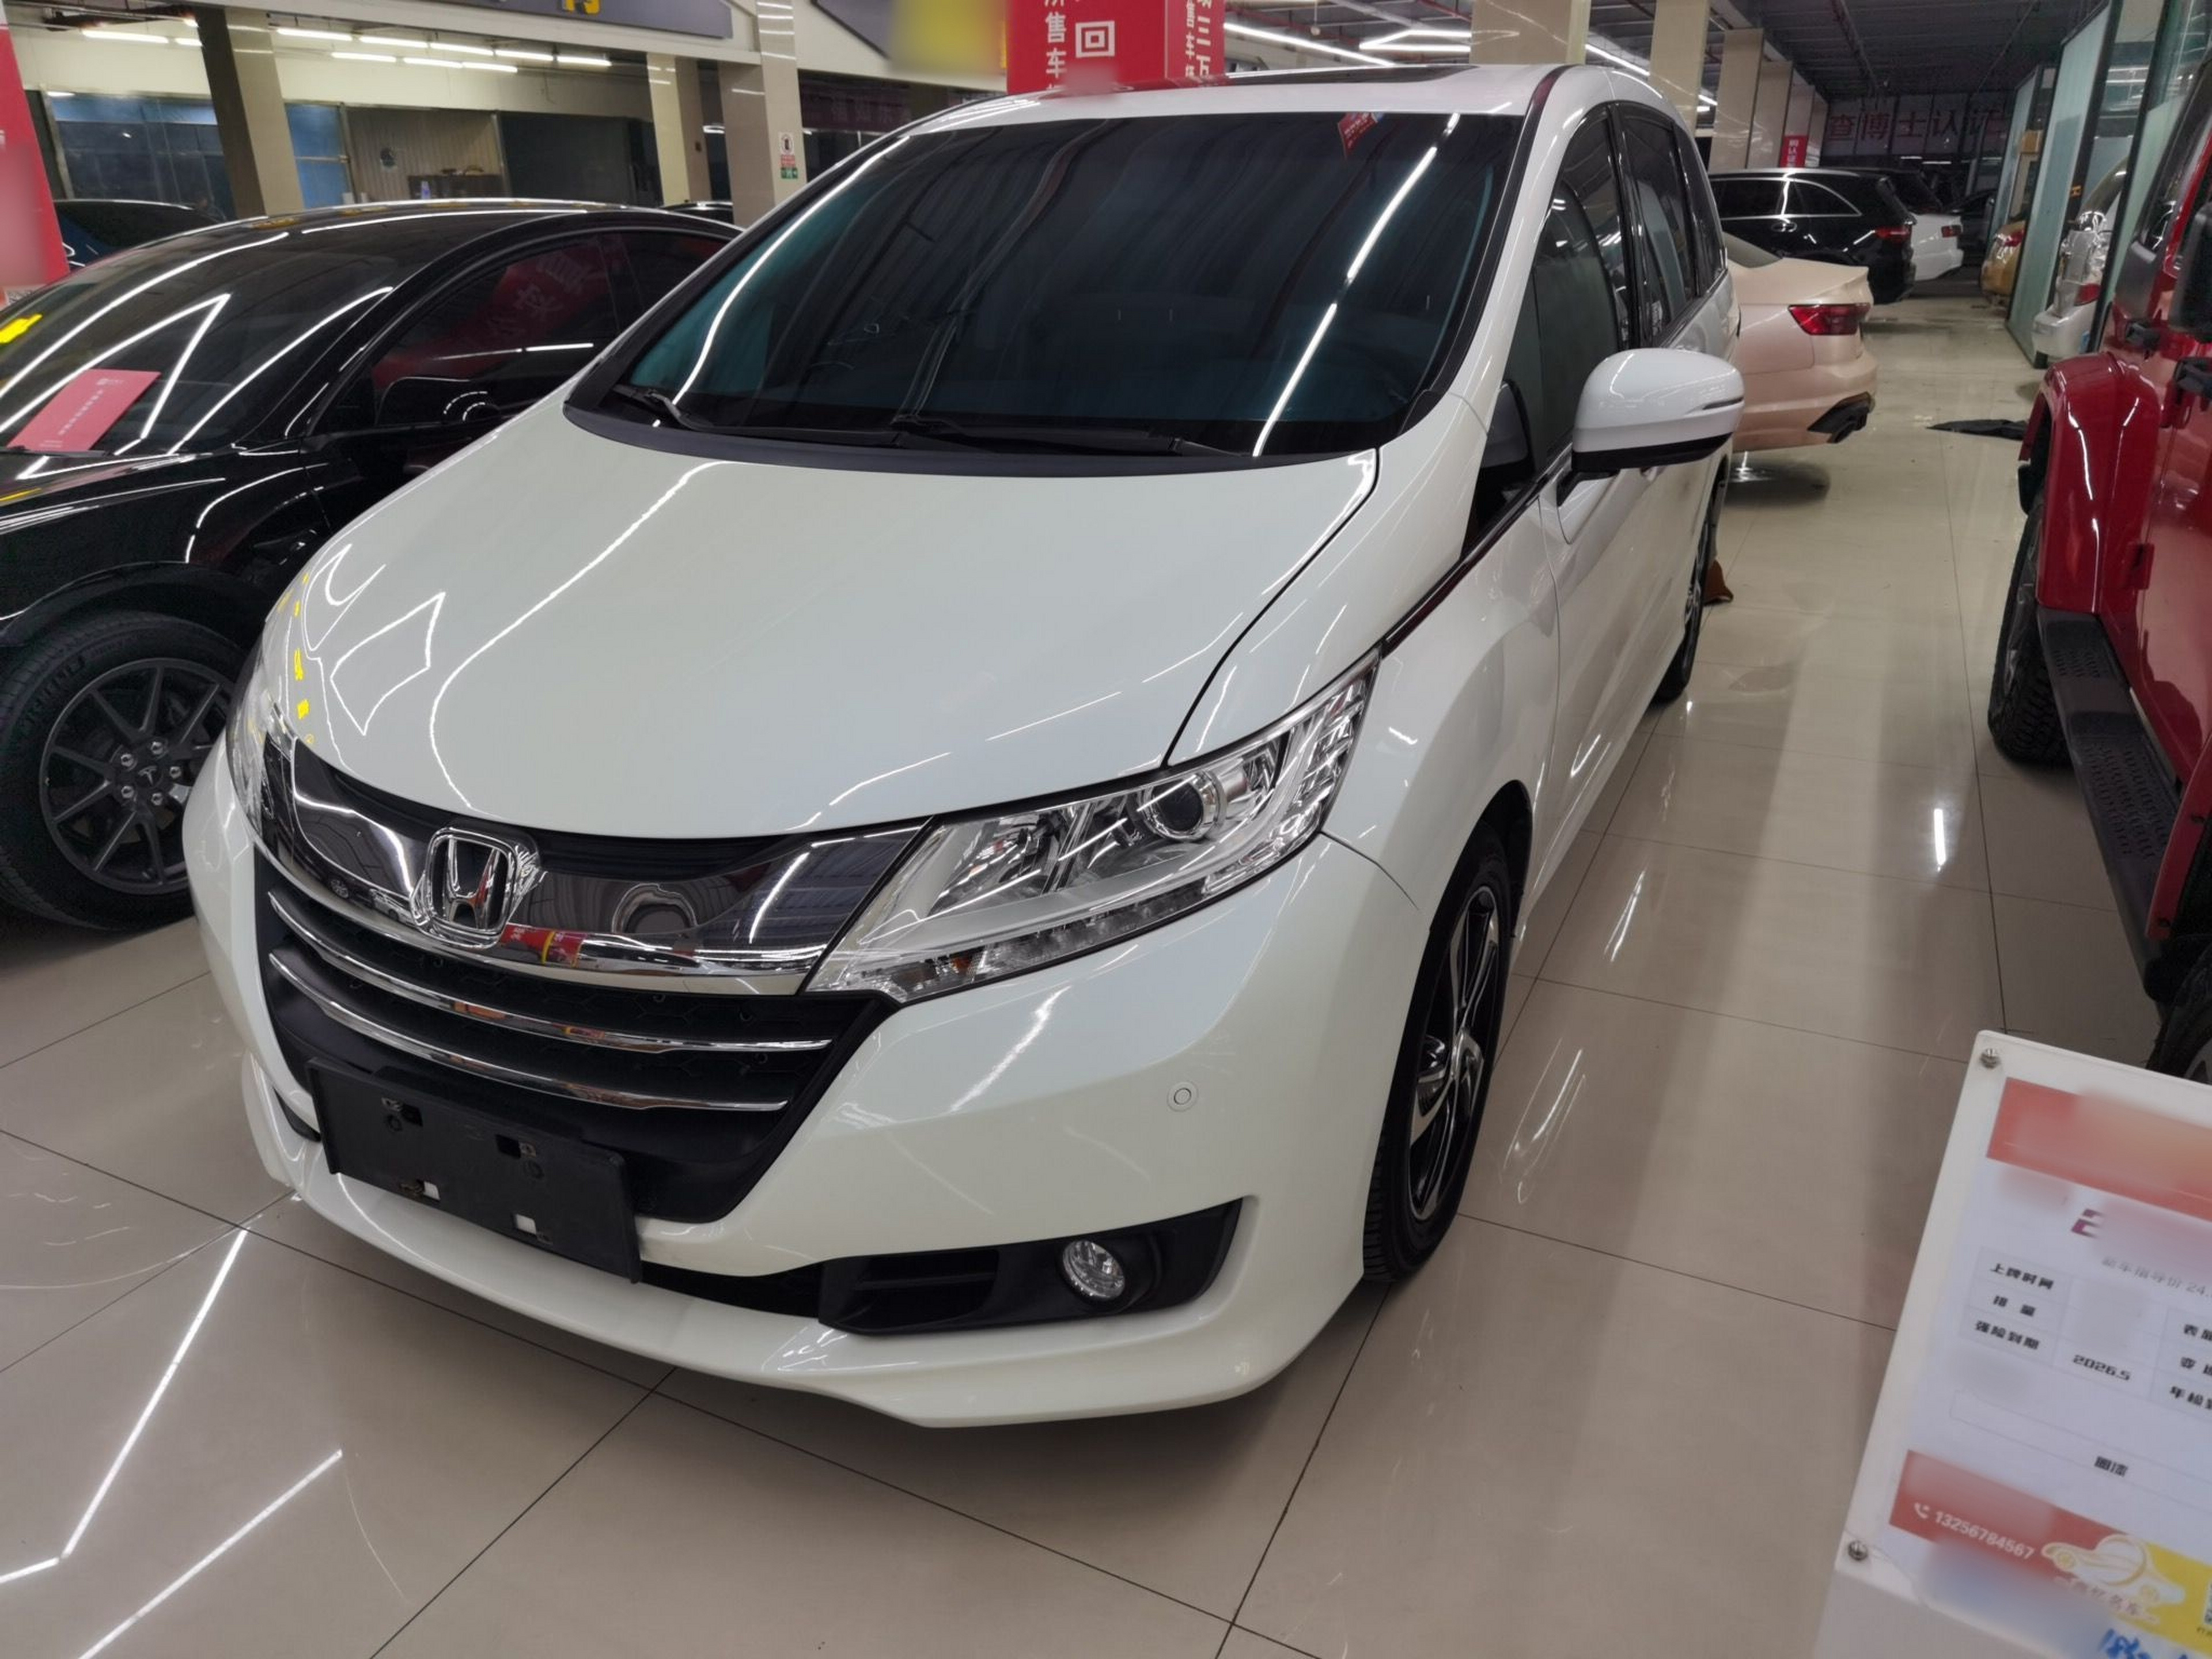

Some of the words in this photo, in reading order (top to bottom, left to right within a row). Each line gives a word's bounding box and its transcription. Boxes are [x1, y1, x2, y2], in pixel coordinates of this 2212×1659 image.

[1990, 1263, 2054, 1290] 上牌时间
[1975, 1320, 2040, 1350] 强险到期
[2073, 1354, 2131, 1381] 2026.5
[1934, 1510, 2036, 1560] 13256784567
